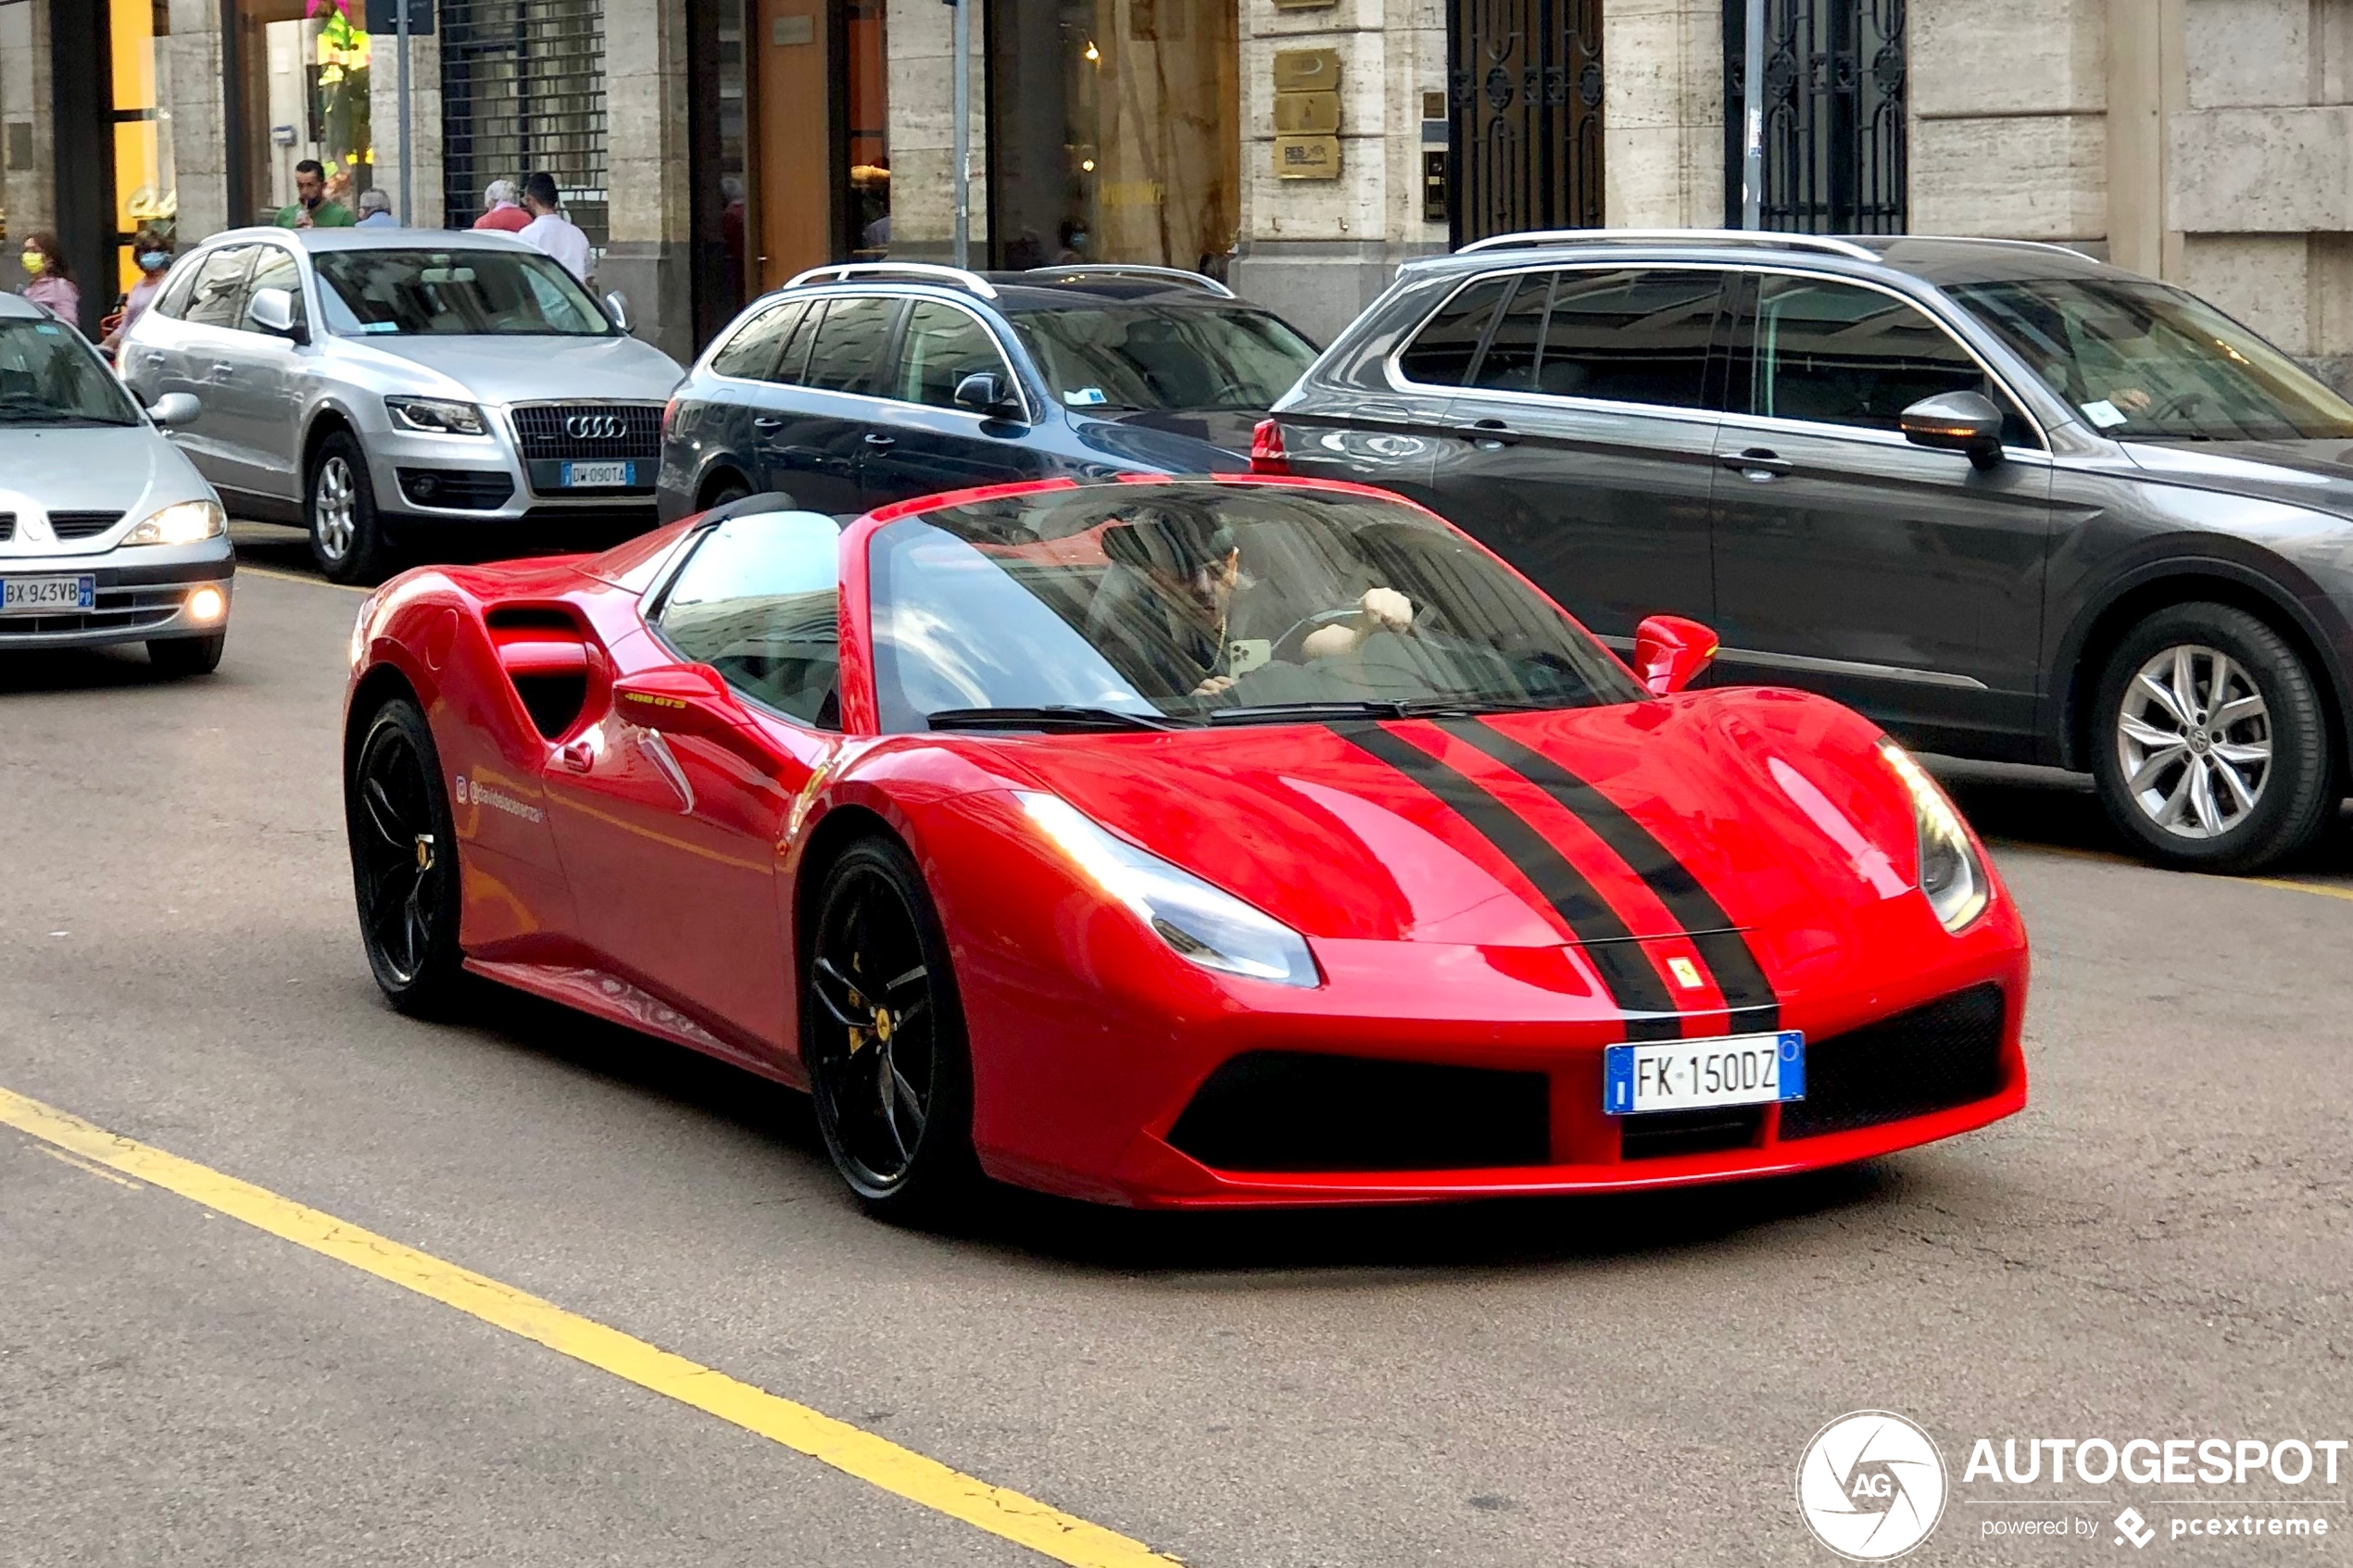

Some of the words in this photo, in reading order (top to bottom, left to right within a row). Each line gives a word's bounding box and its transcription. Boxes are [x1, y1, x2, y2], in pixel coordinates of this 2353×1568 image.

[6, 583, 24, 603] BX
[29, 583, 78, 603] 943VB
[1638, 1056, 1673, 1097] FK
[1690, 1048, 1777, 1096] 150DZ
